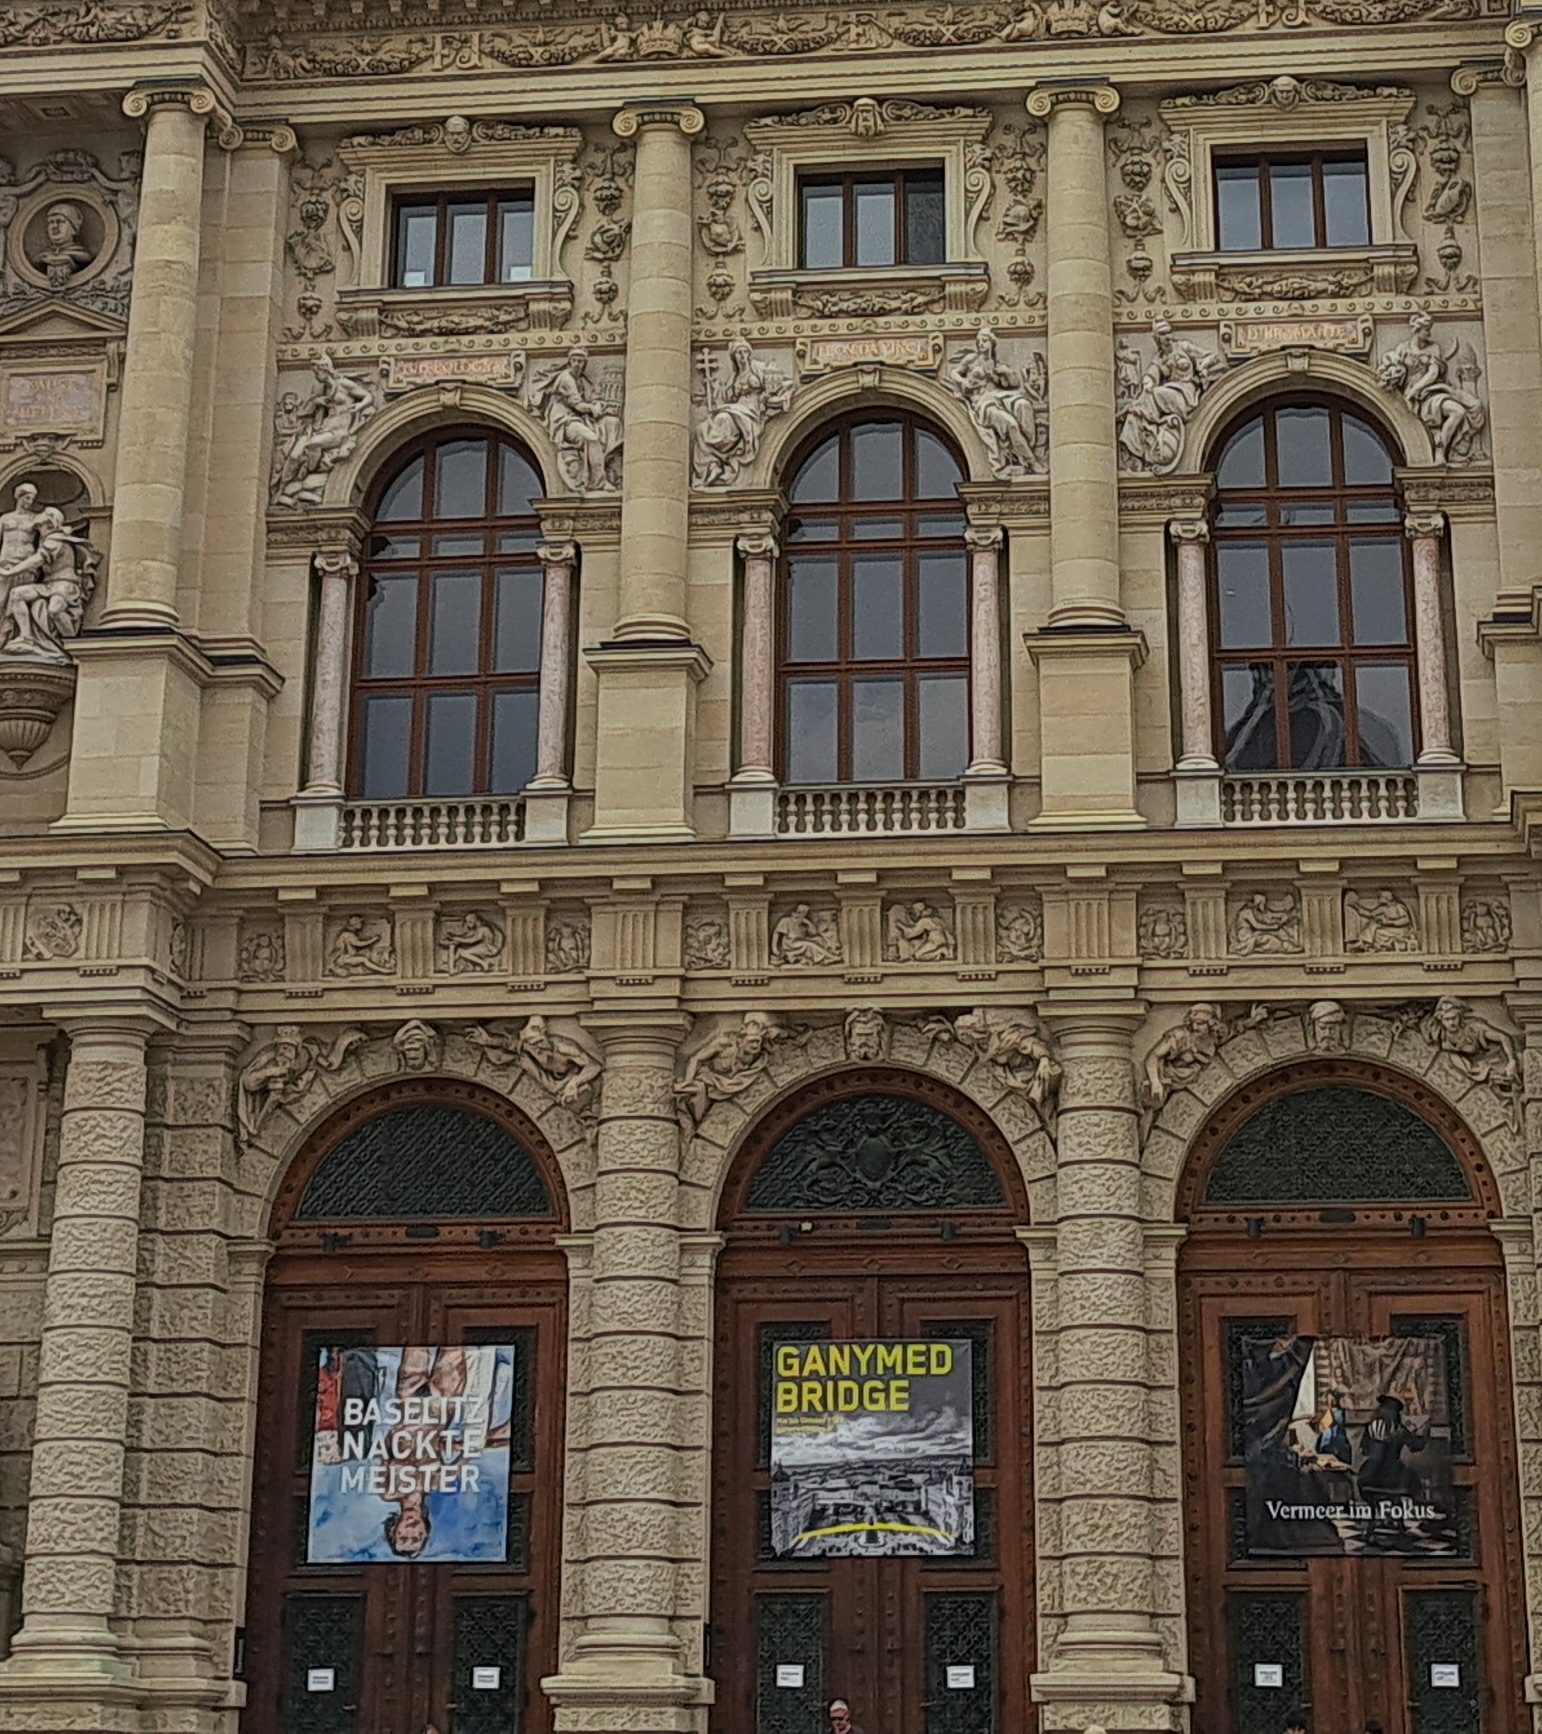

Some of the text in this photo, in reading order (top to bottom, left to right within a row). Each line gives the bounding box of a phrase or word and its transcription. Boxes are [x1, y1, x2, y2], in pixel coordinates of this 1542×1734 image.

[777, 1343, 953, 1377] GANYMED
[344, 1396, 485, 1426] BASELITZ
[776, 1379, 910, 1413] BRIDGE
[342, 1430, 482, 1460] NACKTE
[340, 1465, 481, 1494] MEISTER
[1265, 1496, 1436, 1520] Vermeer im Fokus
